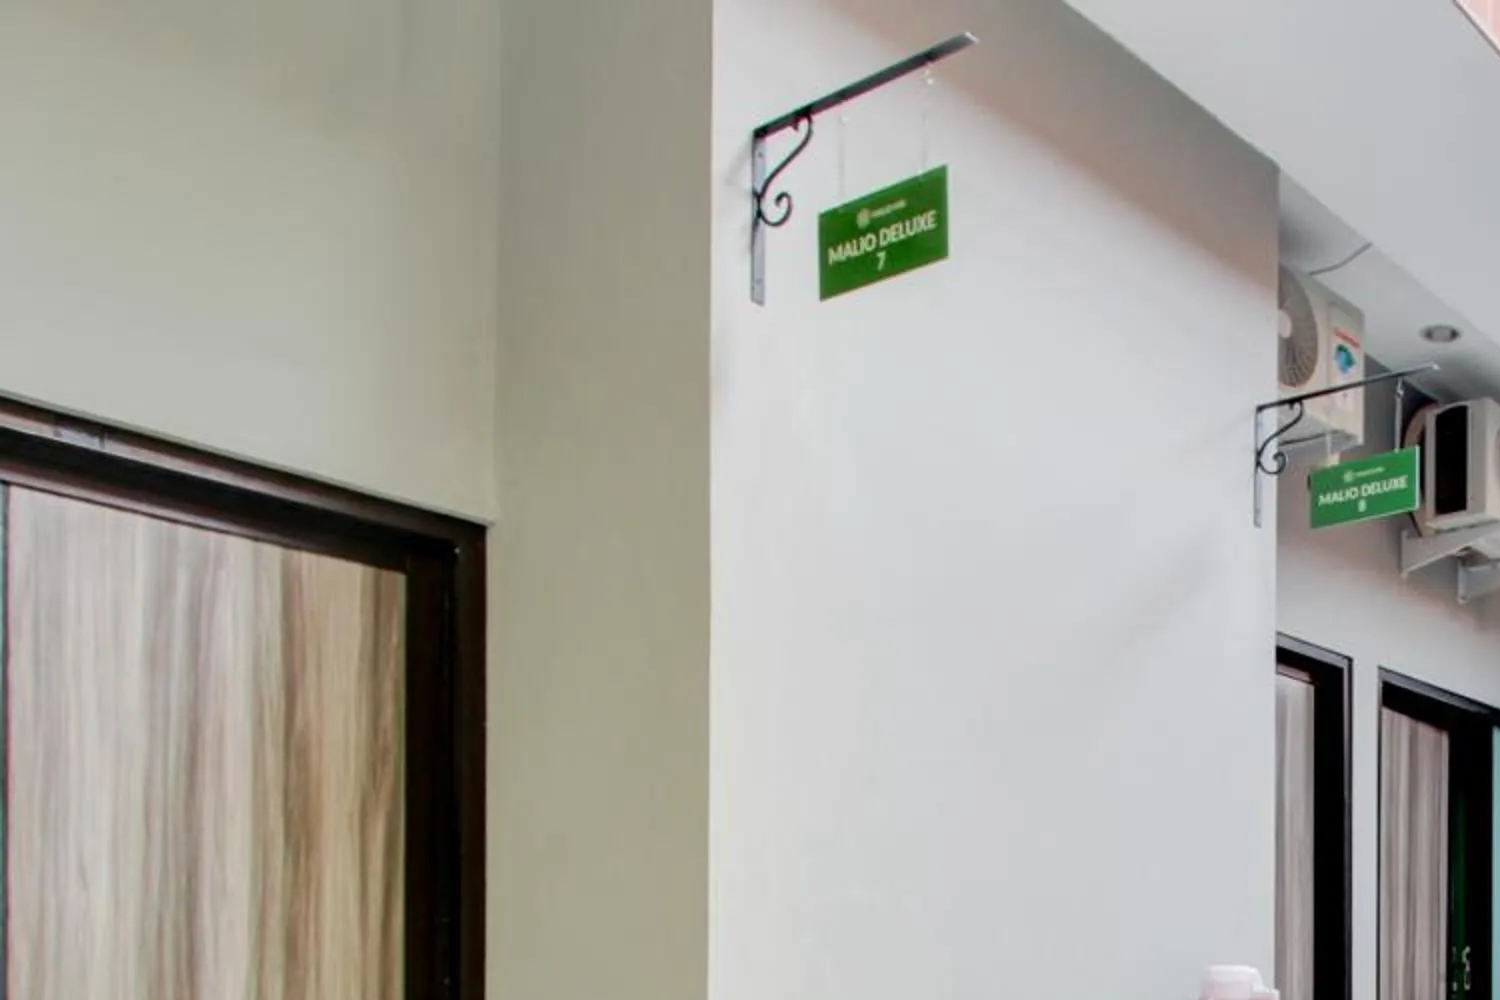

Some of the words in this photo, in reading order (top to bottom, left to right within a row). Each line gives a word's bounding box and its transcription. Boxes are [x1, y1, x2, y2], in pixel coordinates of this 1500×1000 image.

[828, 233, 876, 266] MALIO
[879, 210, 937, 248] DELUXE
[875, 251, 887, 271] 7
[1318, 487, 1359, 506] MALIO
[1361, 475, 1408, 497] DELUXE
